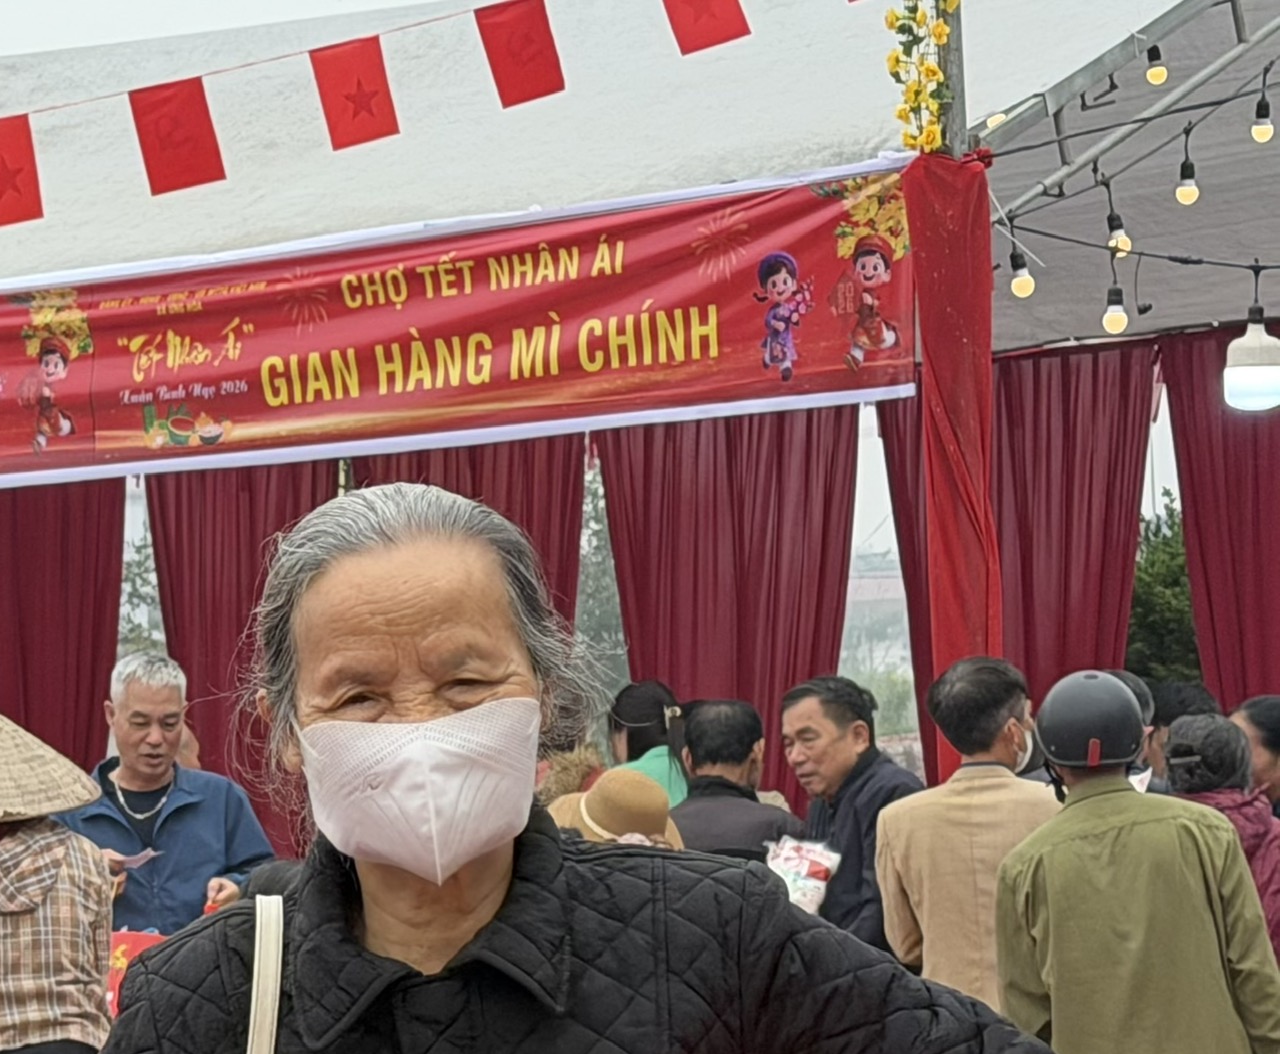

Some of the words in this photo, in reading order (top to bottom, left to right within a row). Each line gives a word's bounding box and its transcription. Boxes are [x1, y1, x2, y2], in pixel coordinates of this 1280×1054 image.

[340, 263, 408, 310] CHỢ
[416, 252, 475, 300] TẾT
[488, 242, 580, 292] NHÂN
[590, 234, 625, 277] ÁI
[219, 379, 248, 396] 2026
[260, 346, 360, 408] GIAN
[375, 327, 493, 395] HÀNG
[509, 311, 561, 382] MÌ
[577, 299, 719, 373] CHÍNH
